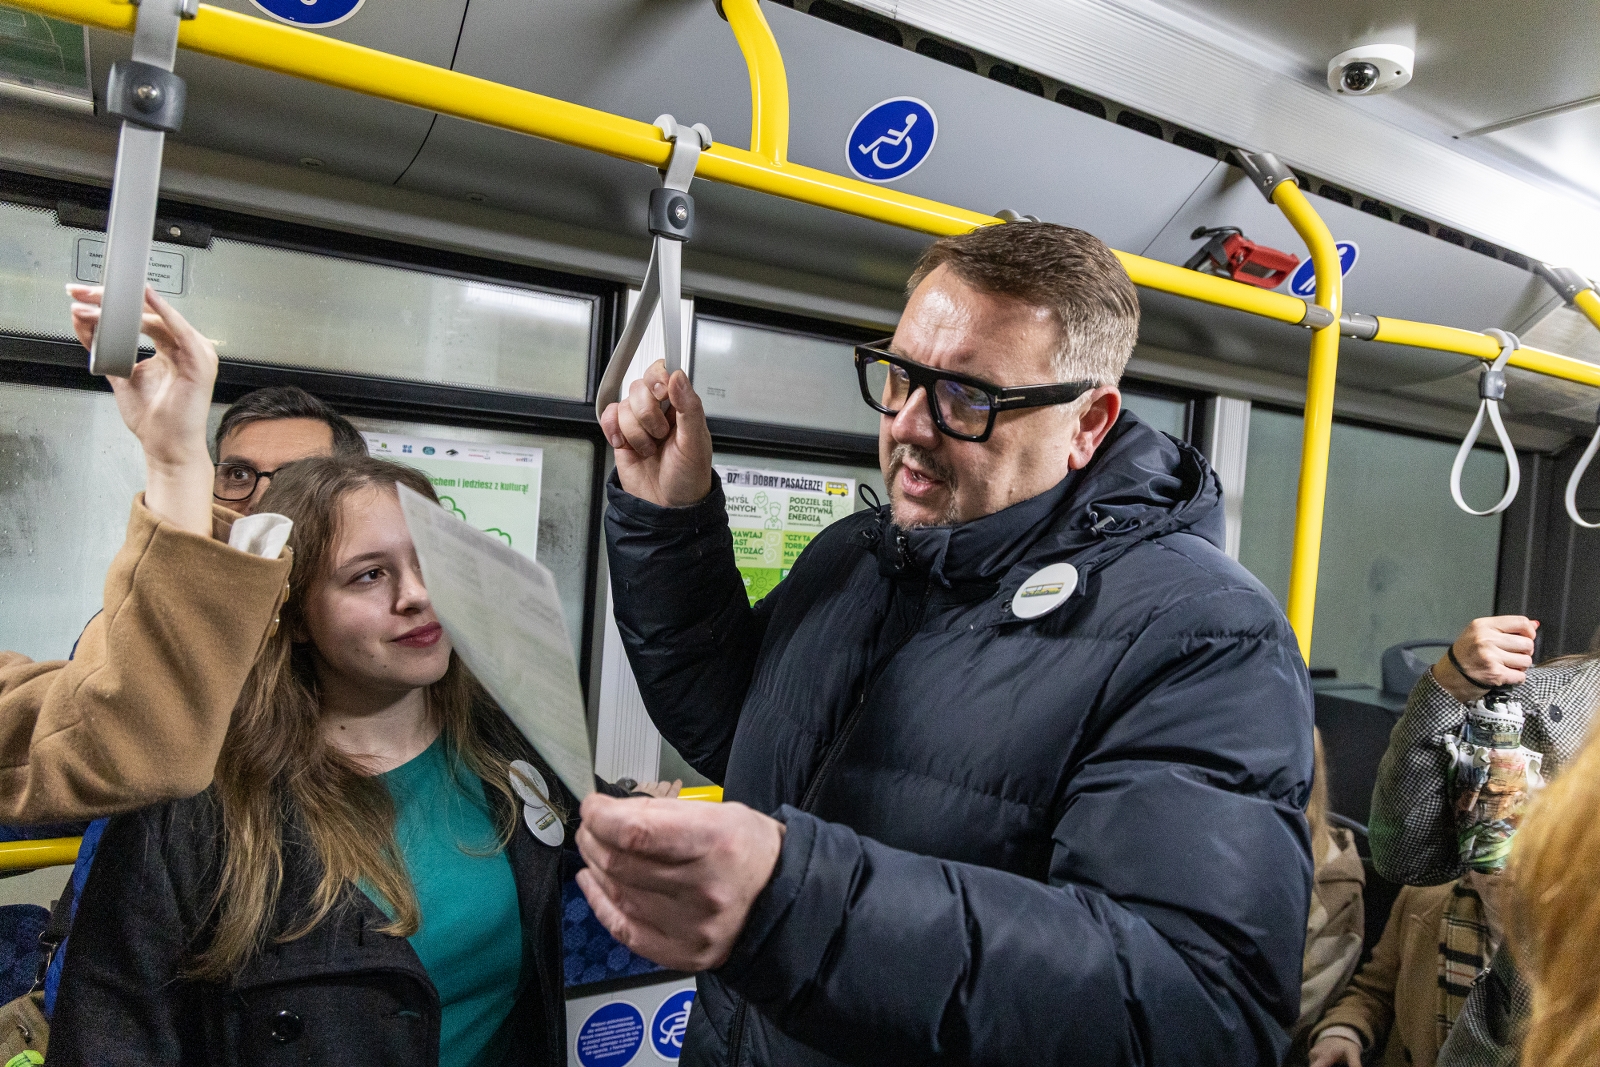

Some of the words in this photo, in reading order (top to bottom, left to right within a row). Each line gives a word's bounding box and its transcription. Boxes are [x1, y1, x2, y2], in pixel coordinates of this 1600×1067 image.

[430, 477, 456, 487] echem
[457, 478, 461, 487] i
[462, 479, 493, 490] jedziesz
[494, 482, 499, 490] z
[500, 482, 529, 495] kulturą!
[752, 474, 779, 488] DOBRY
[781, 476, 823, 491] PASAŻERZE!
[725, 494, 749, 504] MYŚL
[789, 496, 821, 506] PODZIEL
[822, 499, 833, 508] SIĘ
[788, 504, 834, 517] POZYTYWNĄ
[788, 513, 821, 525] ENERGIĄ
[731, 530, 763, 539] MAWIAJ
[733, 538, 748, 546] AST
[734, 545, 764, 555] TYDZAĆ
